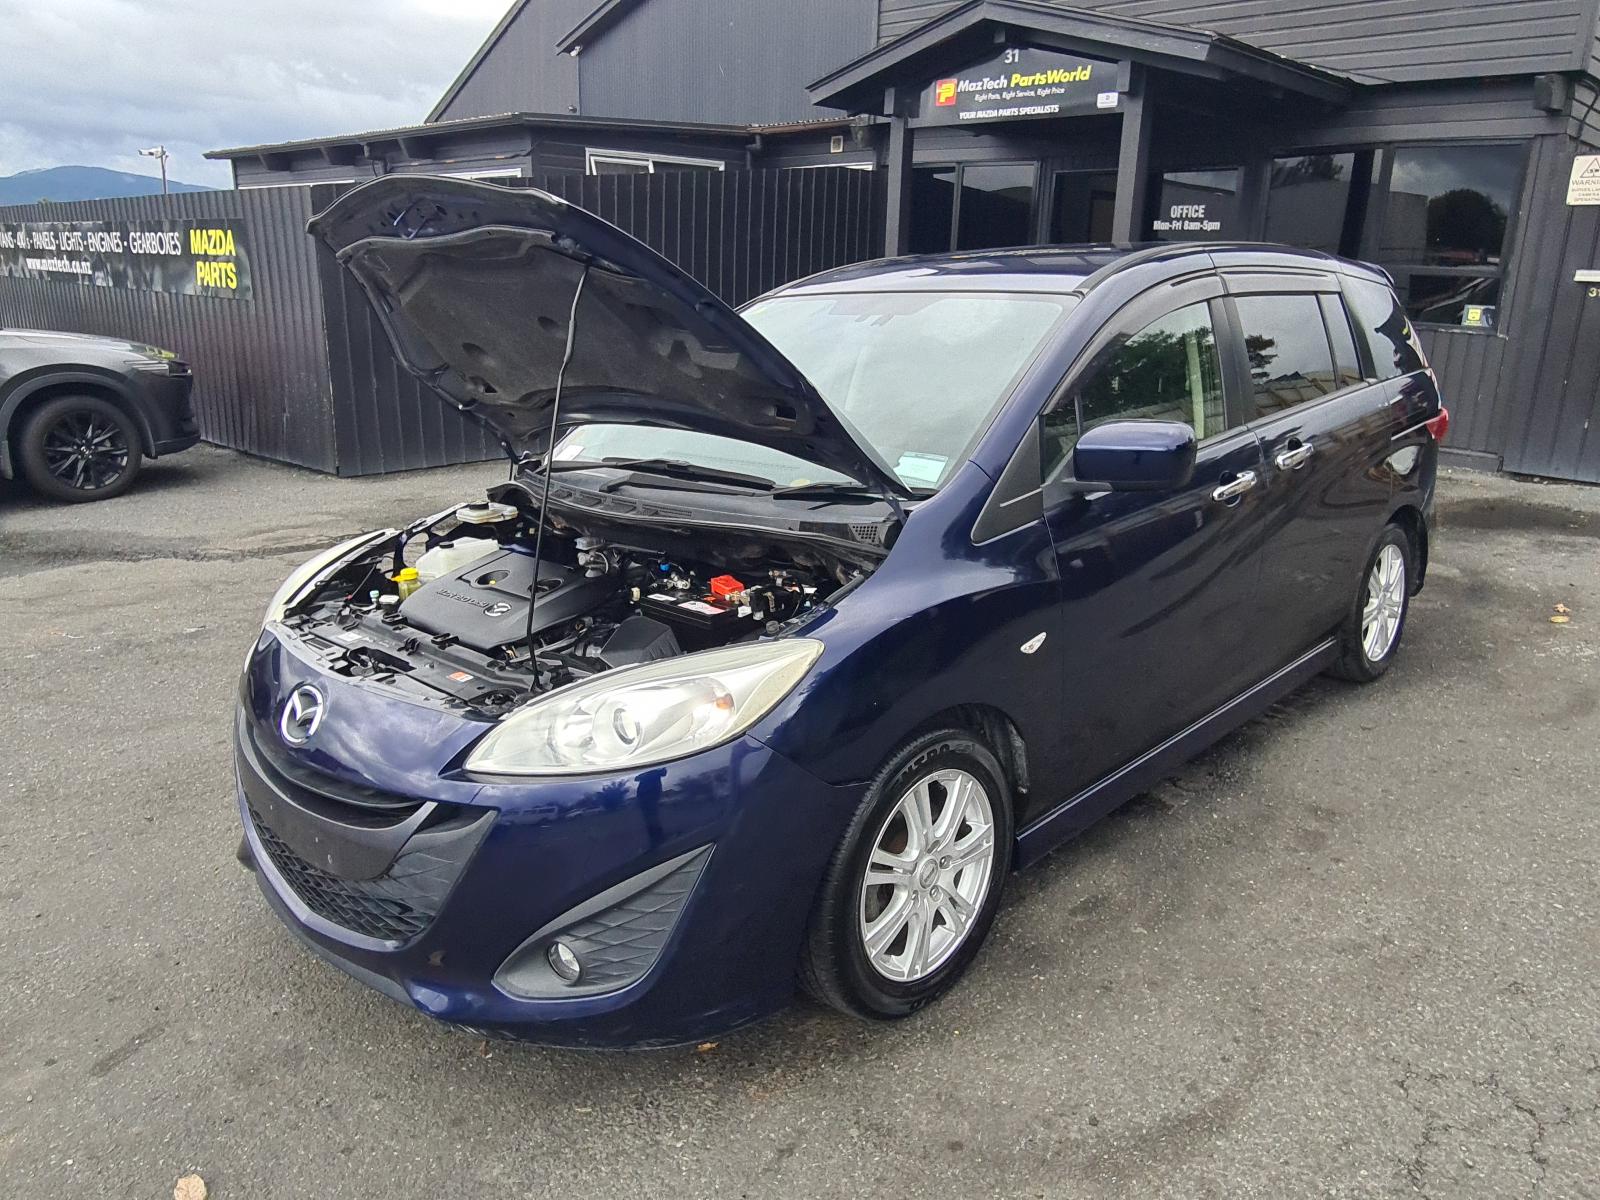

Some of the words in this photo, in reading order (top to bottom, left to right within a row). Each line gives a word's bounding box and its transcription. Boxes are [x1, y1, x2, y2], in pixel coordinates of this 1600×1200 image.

[1004, 48, 1019, 64] 31
[957, 75, 1008, 93] MazTech
[1010, 65, 1092, 88] PartsWorld
[960, 111, 976, 119] YOUR
[977, 109, 997, 118] MAZDA
[999, 107, 1018, 117] PARTS
[1019, 104, 1059, 115] SPECIALISTS
[1170, 205, 1206, 218] OFFICE
[1153, 220, 1183, 231] Mon-Fri
[1183, 220, 1221, 232] 8am-5pm
[32, 231, 56, 250] PANELS
[59, 231, 83, 251] LIGHTS
[87, 231, 122, 253] ENGINES
[129, 231, 181, 255] GEARBOXES
[190, 229, 236, 256] MAZDA
[196, 260, 237, 289] PARTS
